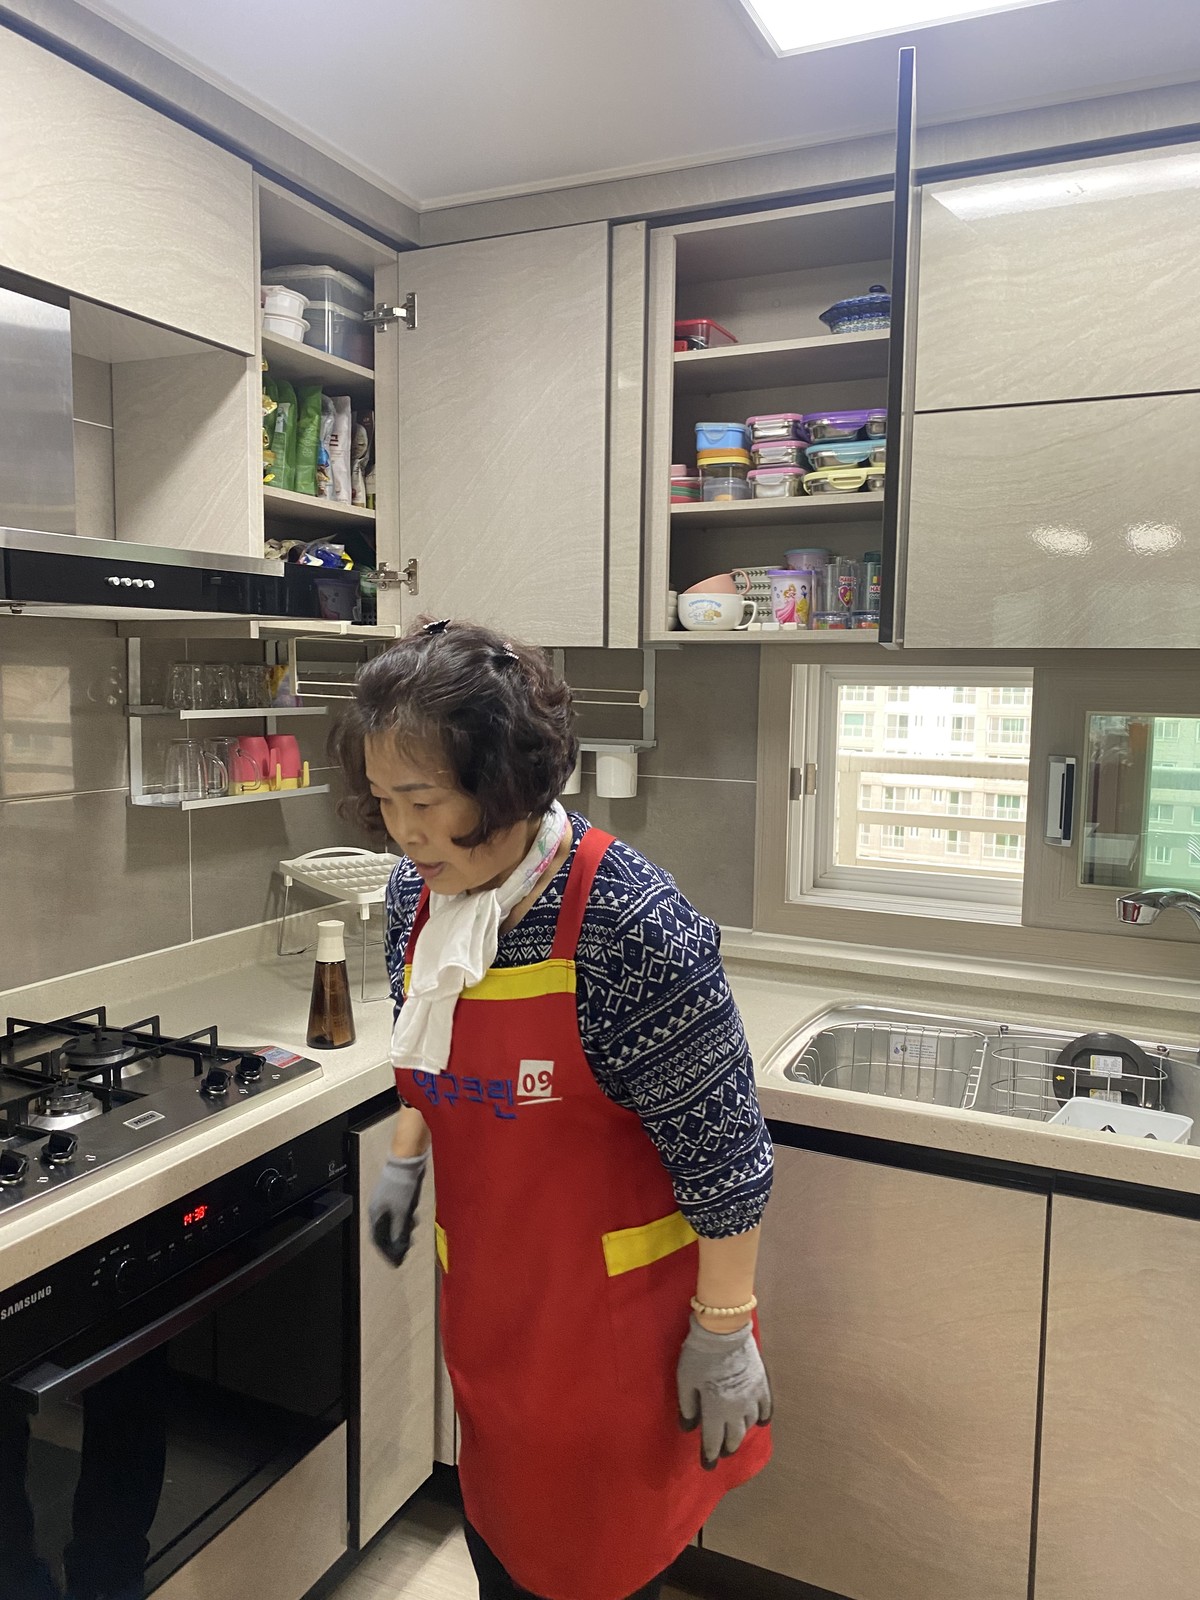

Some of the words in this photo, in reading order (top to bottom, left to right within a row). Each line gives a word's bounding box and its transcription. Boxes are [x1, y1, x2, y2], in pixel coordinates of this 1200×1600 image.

[412, 1069, 517, 1119] 영구크린
[522, 1070, 552, 1093] 09
[1, 1285, 52, 1320] SAMSUNG
